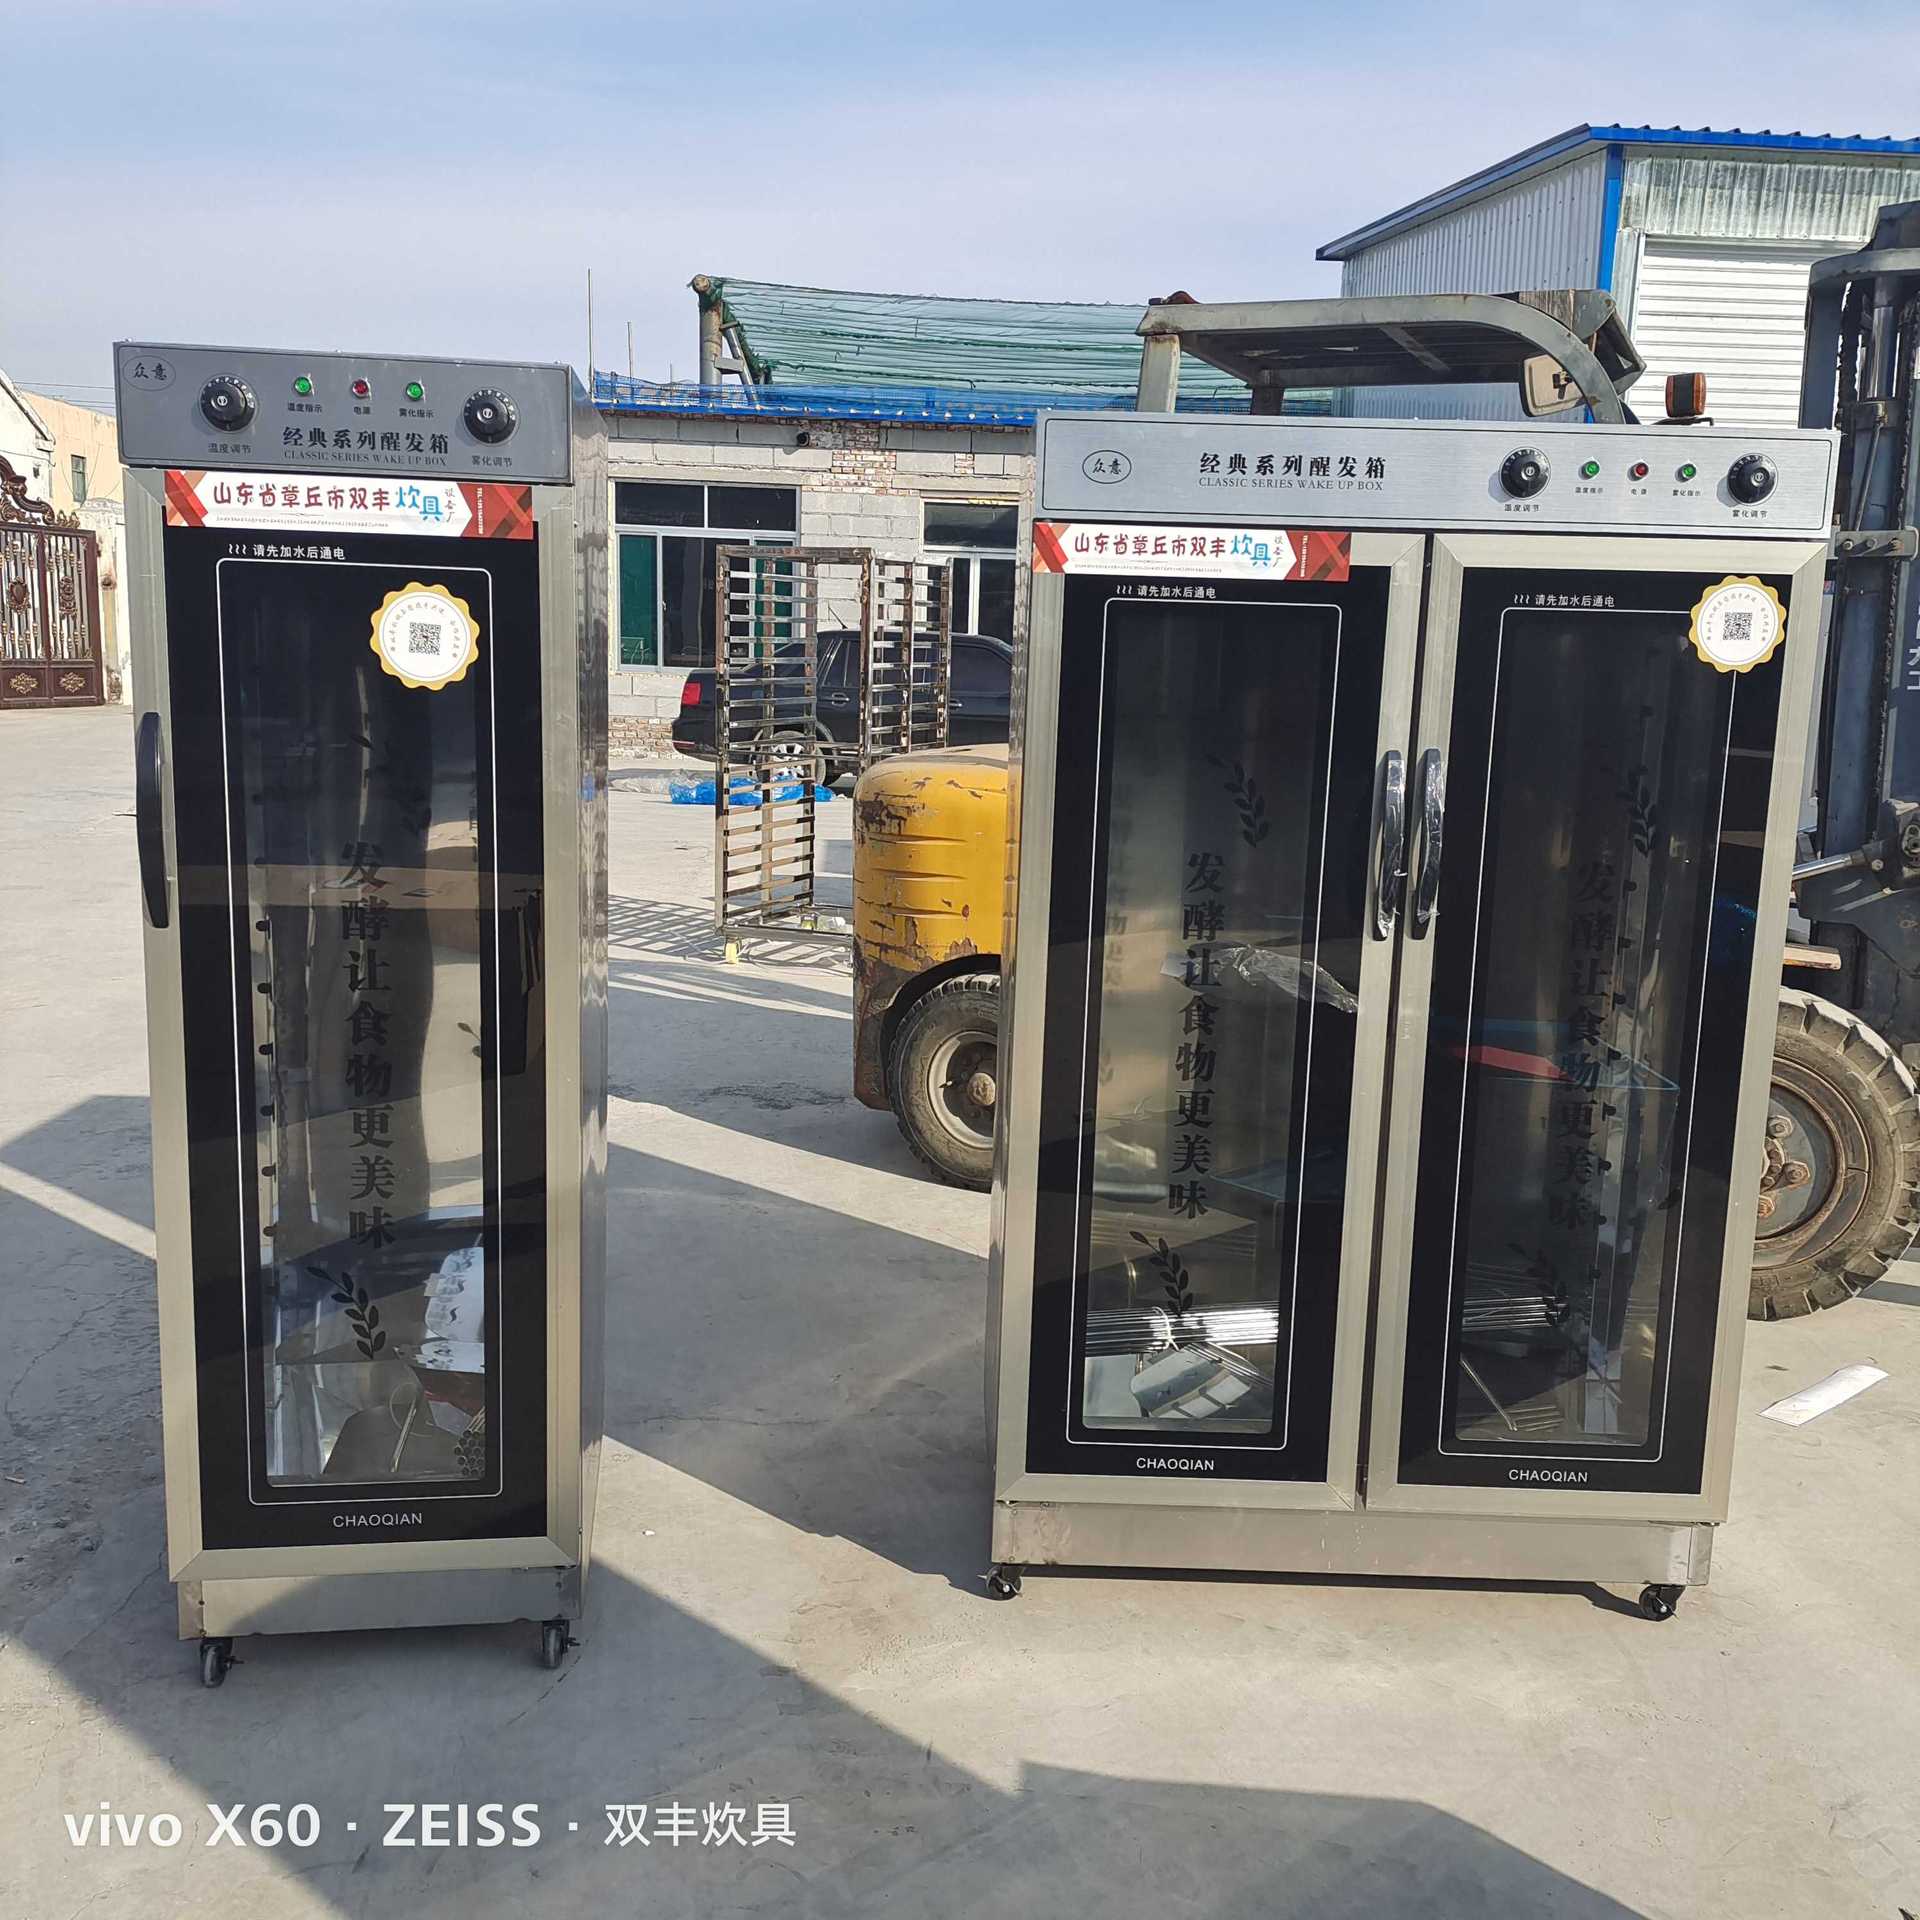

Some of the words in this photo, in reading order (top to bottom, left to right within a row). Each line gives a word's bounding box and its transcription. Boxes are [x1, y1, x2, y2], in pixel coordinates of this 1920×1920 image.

[133, 362, 168, 381] 众意
[207, 442, 252, 454] 温度调节
[282, 426, 449, 454] 经典系列醒发箱
[284, 450, 329, 460] CLASSIC
[331, 452, 370, 463] SERIES
[371, 453, 405, 464] WAKE
[408, 455, 422, 465] UP
[425, 456, 448, 467] BOX
[1092, 457, 1122, 476] 众意
[1198, 452, 1386, 479] 经典系列醒发箱
[1198, 476, 1248, 488] CLASSIC
[1251, 477, 1294, 489] SERIES
[1297, 479, 1334, 490] WAKE
[1337, 479, 1354, 491] UP
[1357, 480, 1384, 492] BOX
[213, 482, 443, 522] 山东省章丘市双丰炊具
[252, 543, 346, 560] 请先加水后通电
[1074, 532, 1271, 567] 山东省章丘市双丰炊具
[1136, 584, 1217, 599] 请先加水后通电
[1534, 593, 1616, 608] 请先加水后通电
[1168, 852, 1226, 1220] 发酵让食物更美味
[340, 841, 396, 1250] 发酵让食物更美味
[1547, 860, 1616, 1231] 发酵让食物更美味
[1136, 1457, 1215, 1472] CHAOQIAN
[1508, 1468, 1589, 1484] CHAOQIAN
[333, 1512, 423, 1528] CHAOQIAN
